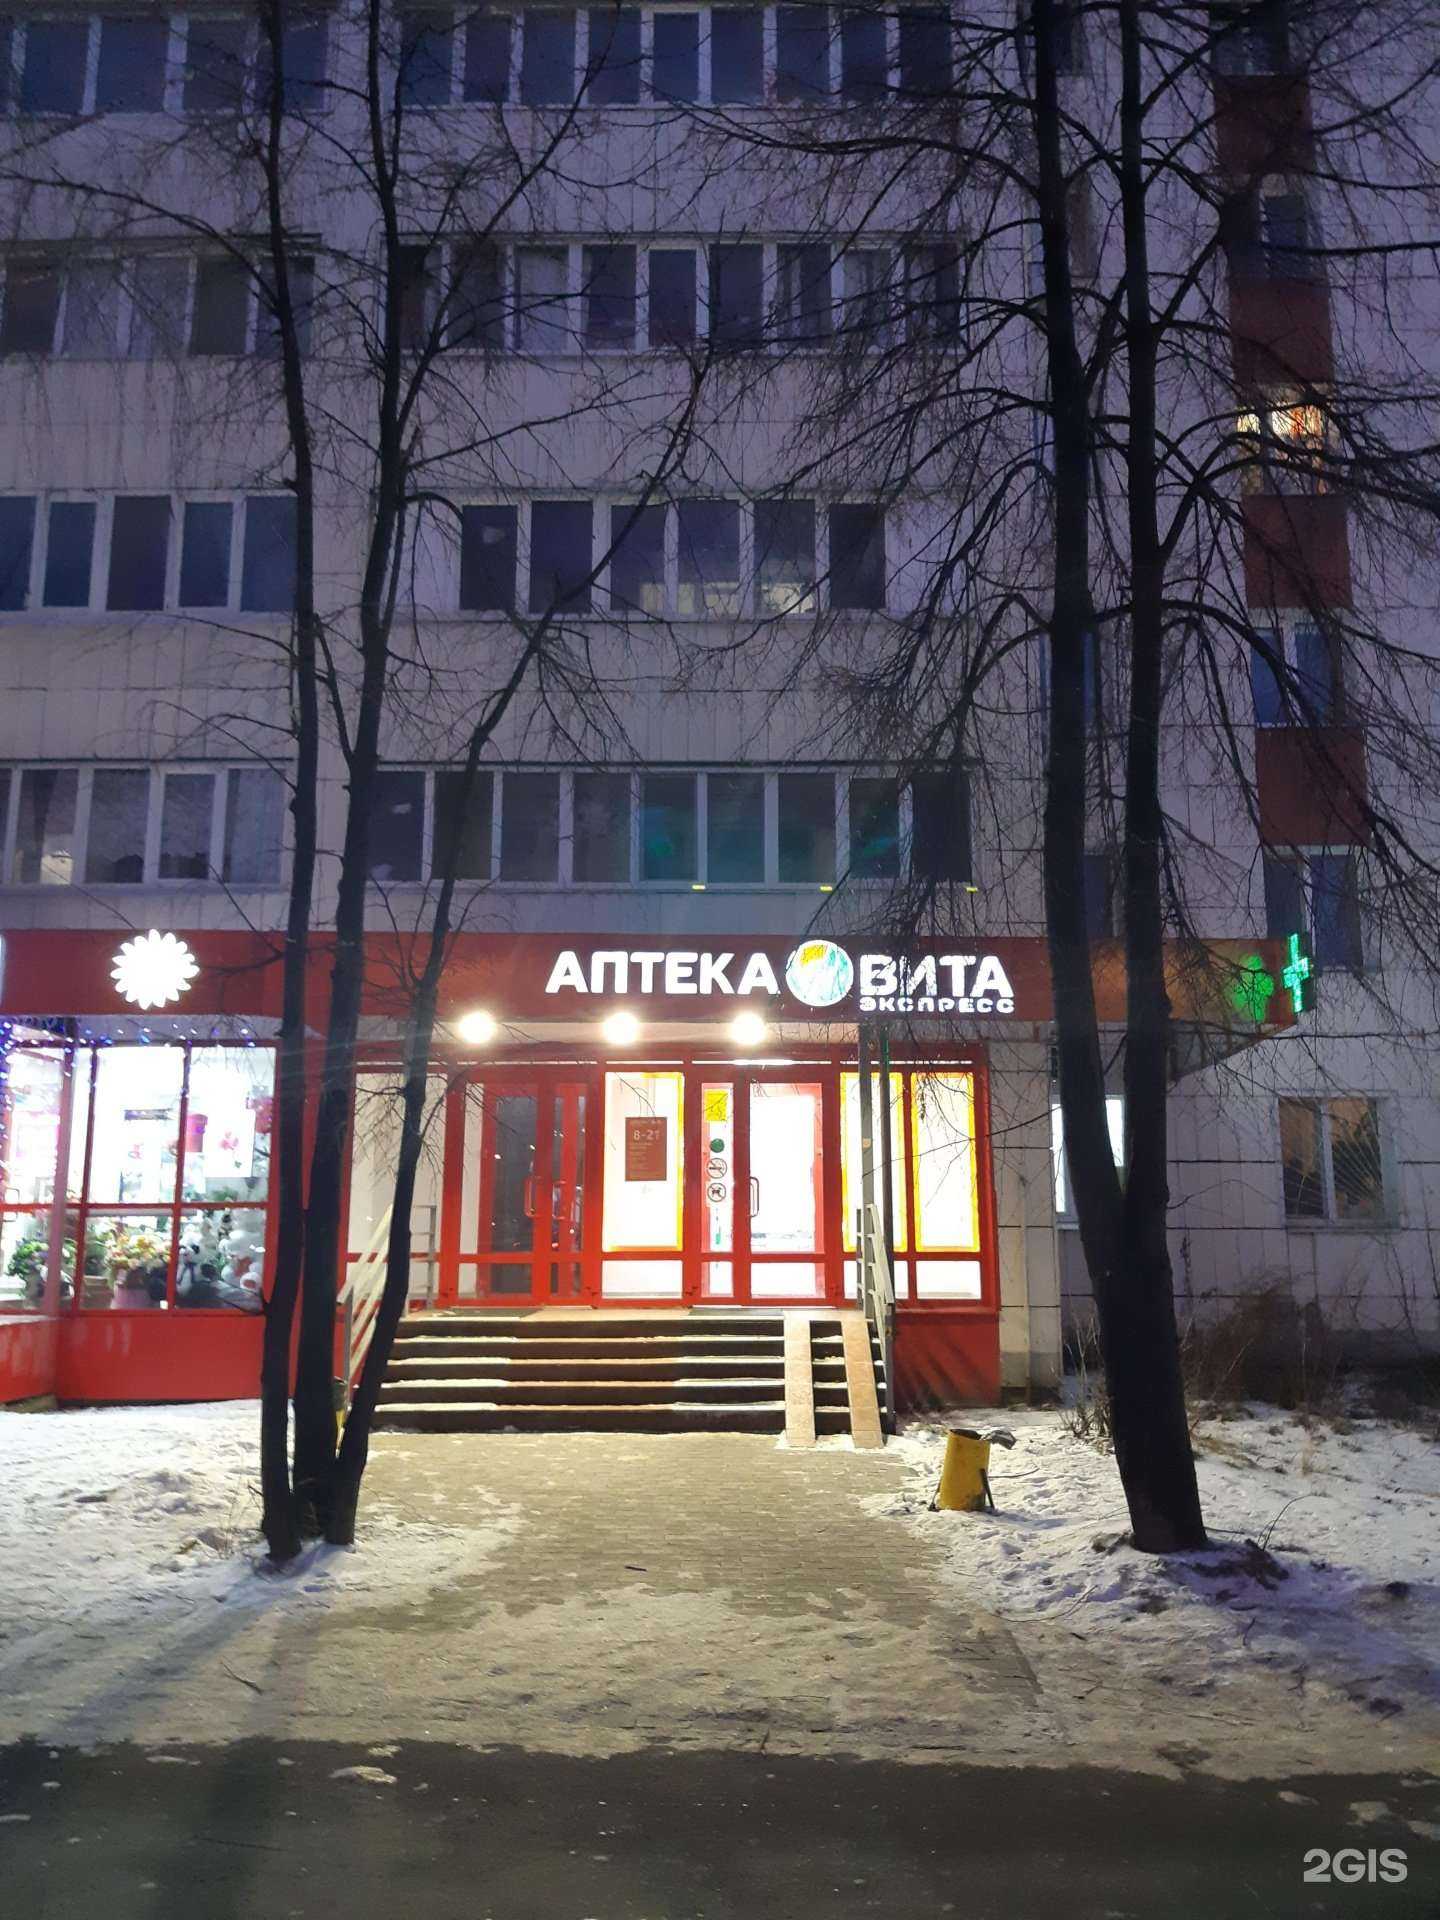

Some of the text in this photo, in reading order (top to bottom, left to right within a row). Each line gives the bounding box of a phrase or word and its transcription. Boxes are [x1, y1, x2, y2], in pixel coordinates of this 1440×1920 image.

[545, 950, 1014, 998] АПТЕКА ВИТА
[859, 996, 1015, 1014] ЭКСПРЕСС
